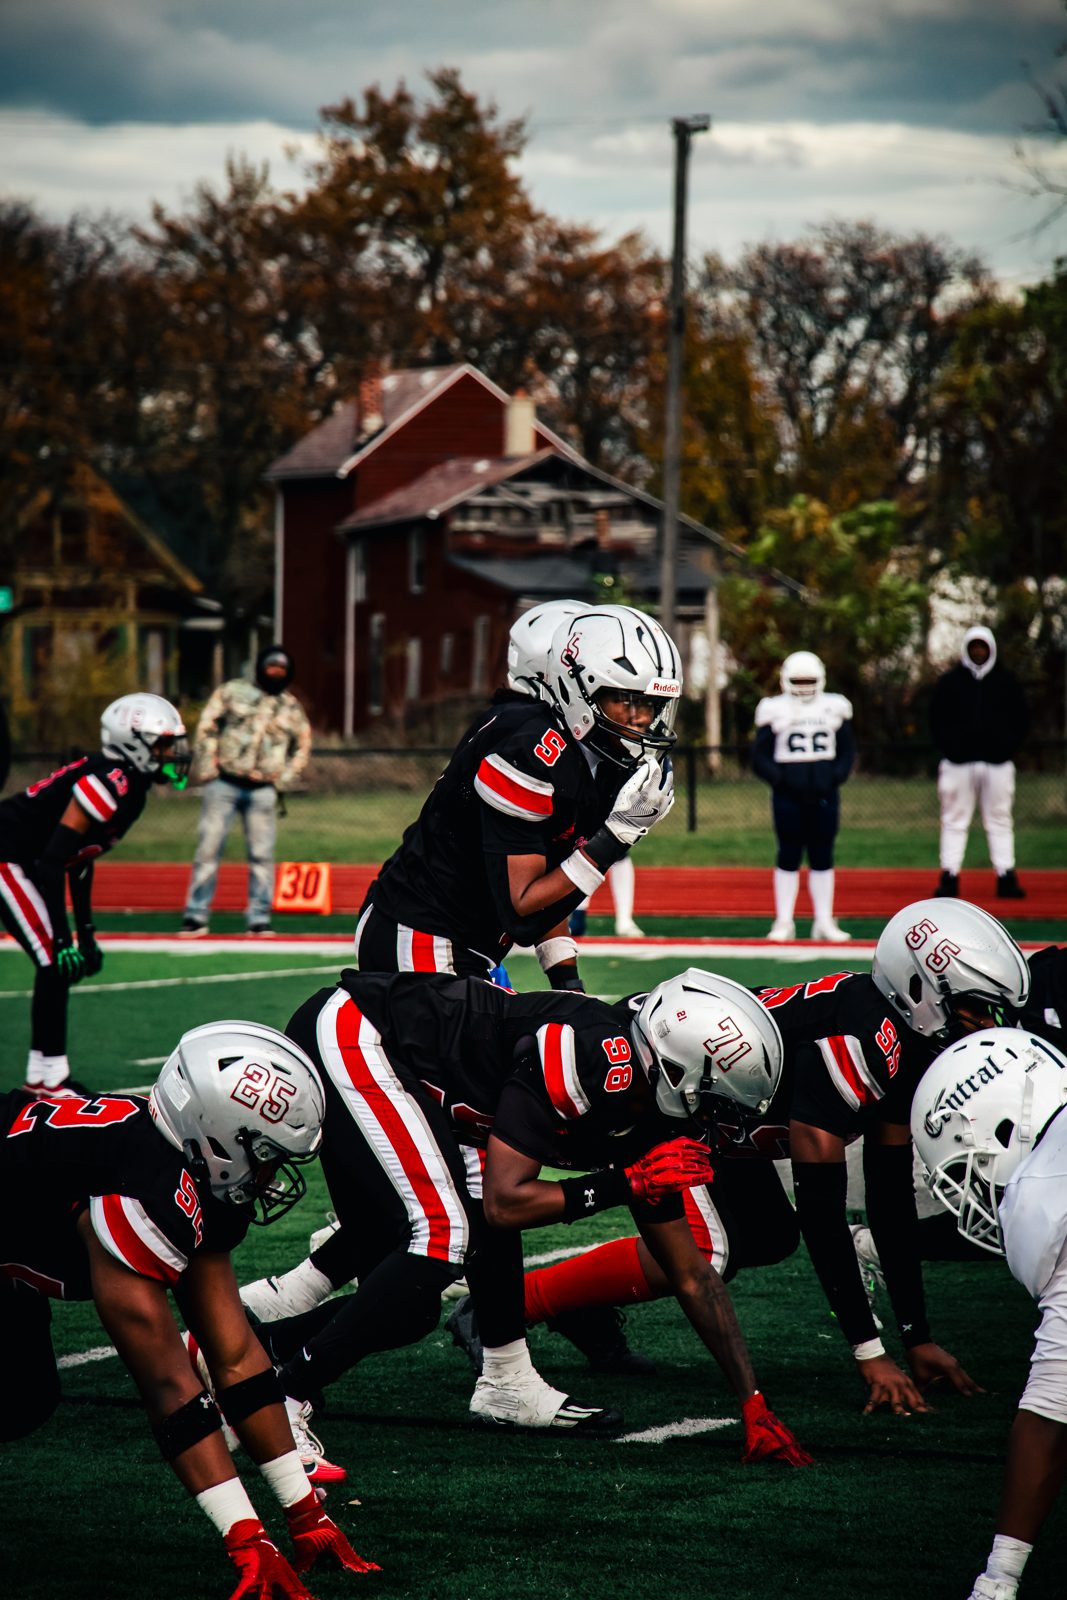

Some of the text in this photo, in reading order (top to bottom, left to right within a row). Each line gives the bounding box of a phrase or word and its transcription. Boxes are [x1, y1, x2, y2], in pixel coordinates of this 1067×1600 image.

[653, 682, 680, 693] Riddell
[533, 728, 567, 767] 5
[281, 865, 321, 900] 30
[905, 918, 961, 973] 55
[602, 1036, 633, 1093] 98
[703, 1016, 753, 1073] 71
[230, 1063, 298, 1125] 25
[924, 1054, 1004, 1139] Central
